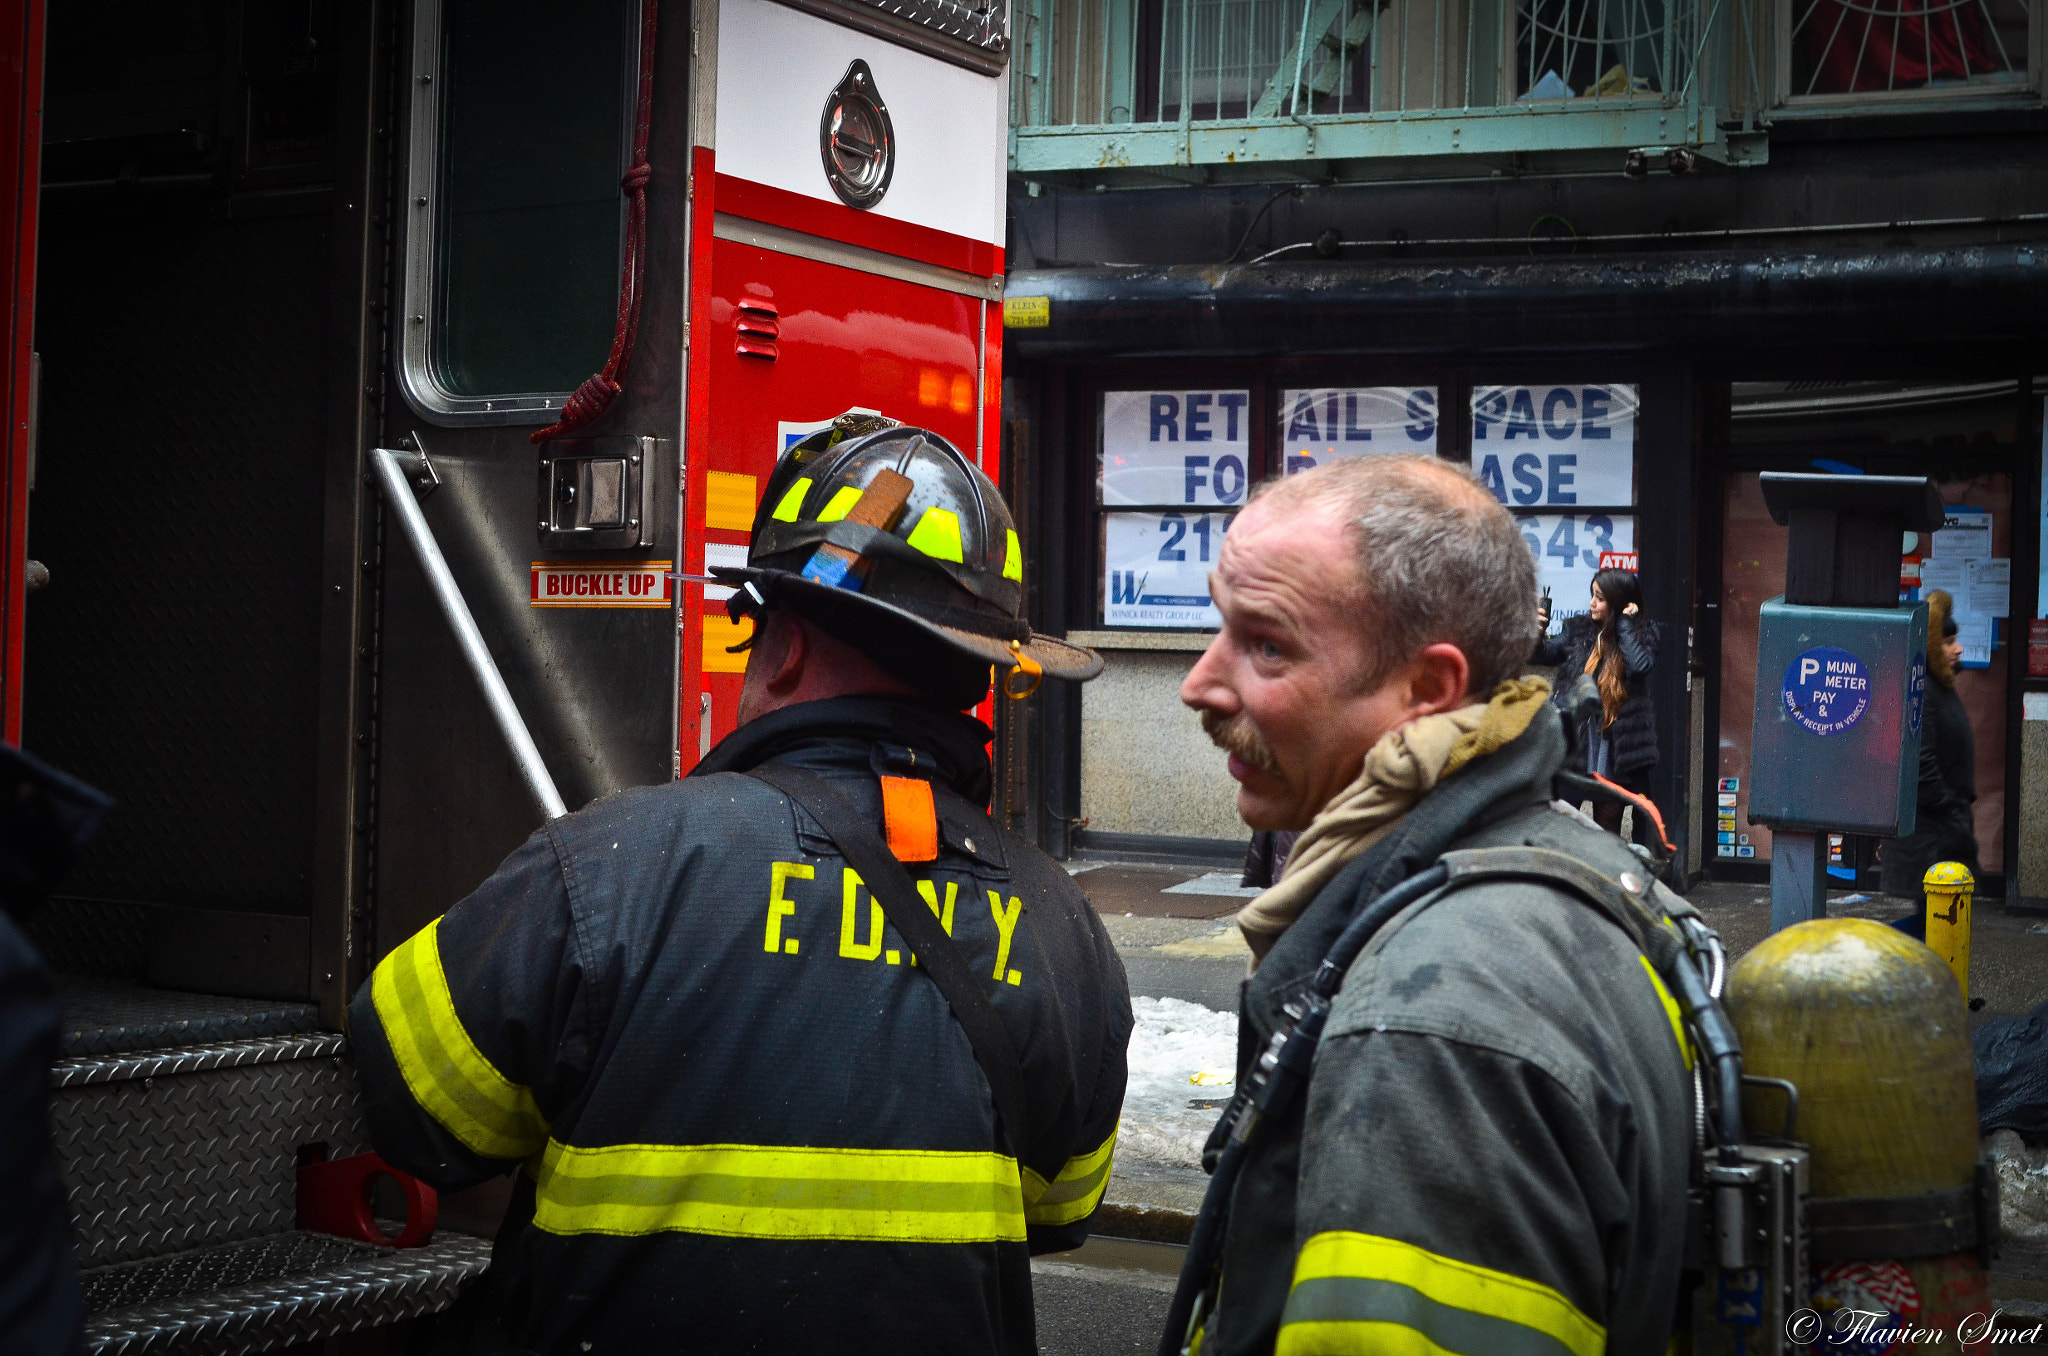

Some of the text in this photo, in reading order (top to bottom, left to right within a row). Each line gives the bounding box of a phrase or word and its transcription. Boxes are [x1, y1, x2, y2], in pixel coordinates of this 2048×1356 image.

[1158, 512, 1235, 562] 21
[1600, 555, 1637, 570] ATM
[546, 574, 656, 596] BUCKLE UP
[1112, 610, 1138, 619] WINICK
[1140, 610, 1163, 620] REALTY
[1165, 611, 1191, 620] GROUP
[1800, 658, 1857, 685] P MUNI
[1825, 675, 1867, 690] METER
[1813, 690, 1837, 704] PAY
[1803, 718, 1834, 732] RECEIPT
[1835, 721, 1844, 731] IN
[1844, 697, 1867, 725] VEHICLE
[1818, 704, 1828, 717] &
